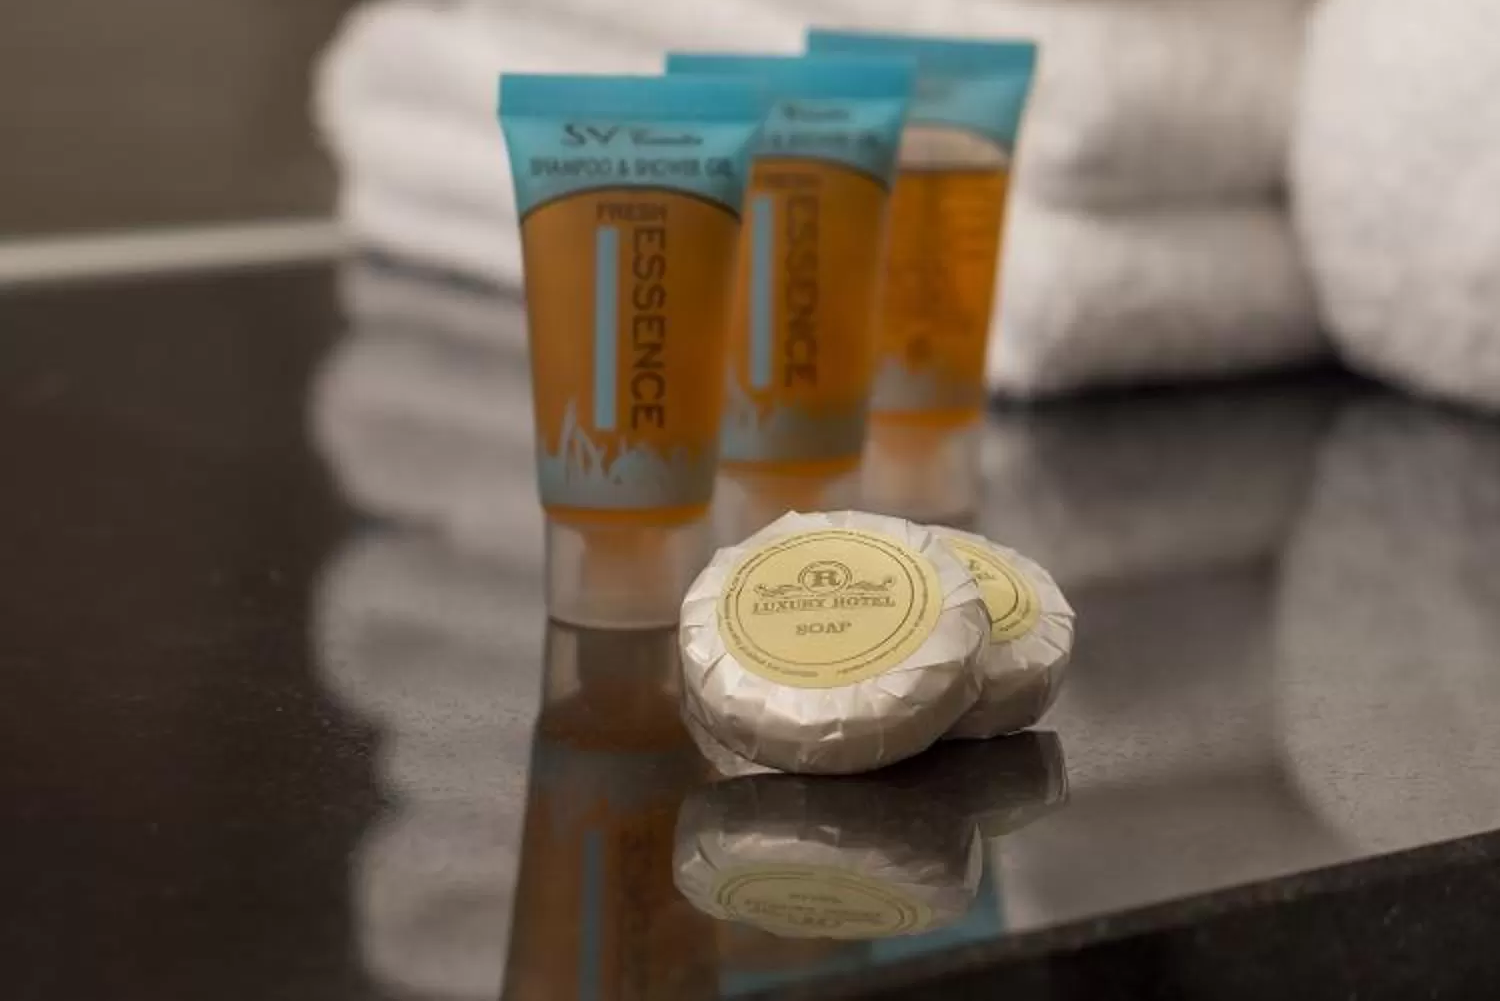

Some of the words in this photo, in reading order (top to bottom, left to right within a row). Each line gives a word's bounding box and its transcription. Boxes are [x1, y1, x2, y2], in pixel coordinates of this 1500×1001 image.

[530, 156, 612, 177] SHAMPOO
[634, 157, 700, 177] SHOWER
[595, 202, 669, 222] FRESH
[784, 194, 819, 387] ESSENCE
[630, 225, 667, 431] ESSENCE
[811, 569, 841, 588] R
[752, 597, 828, 615] LUXURY
[831, 595, 897, 610] HOTEL
[795, 621, 853, 636] SOAP
